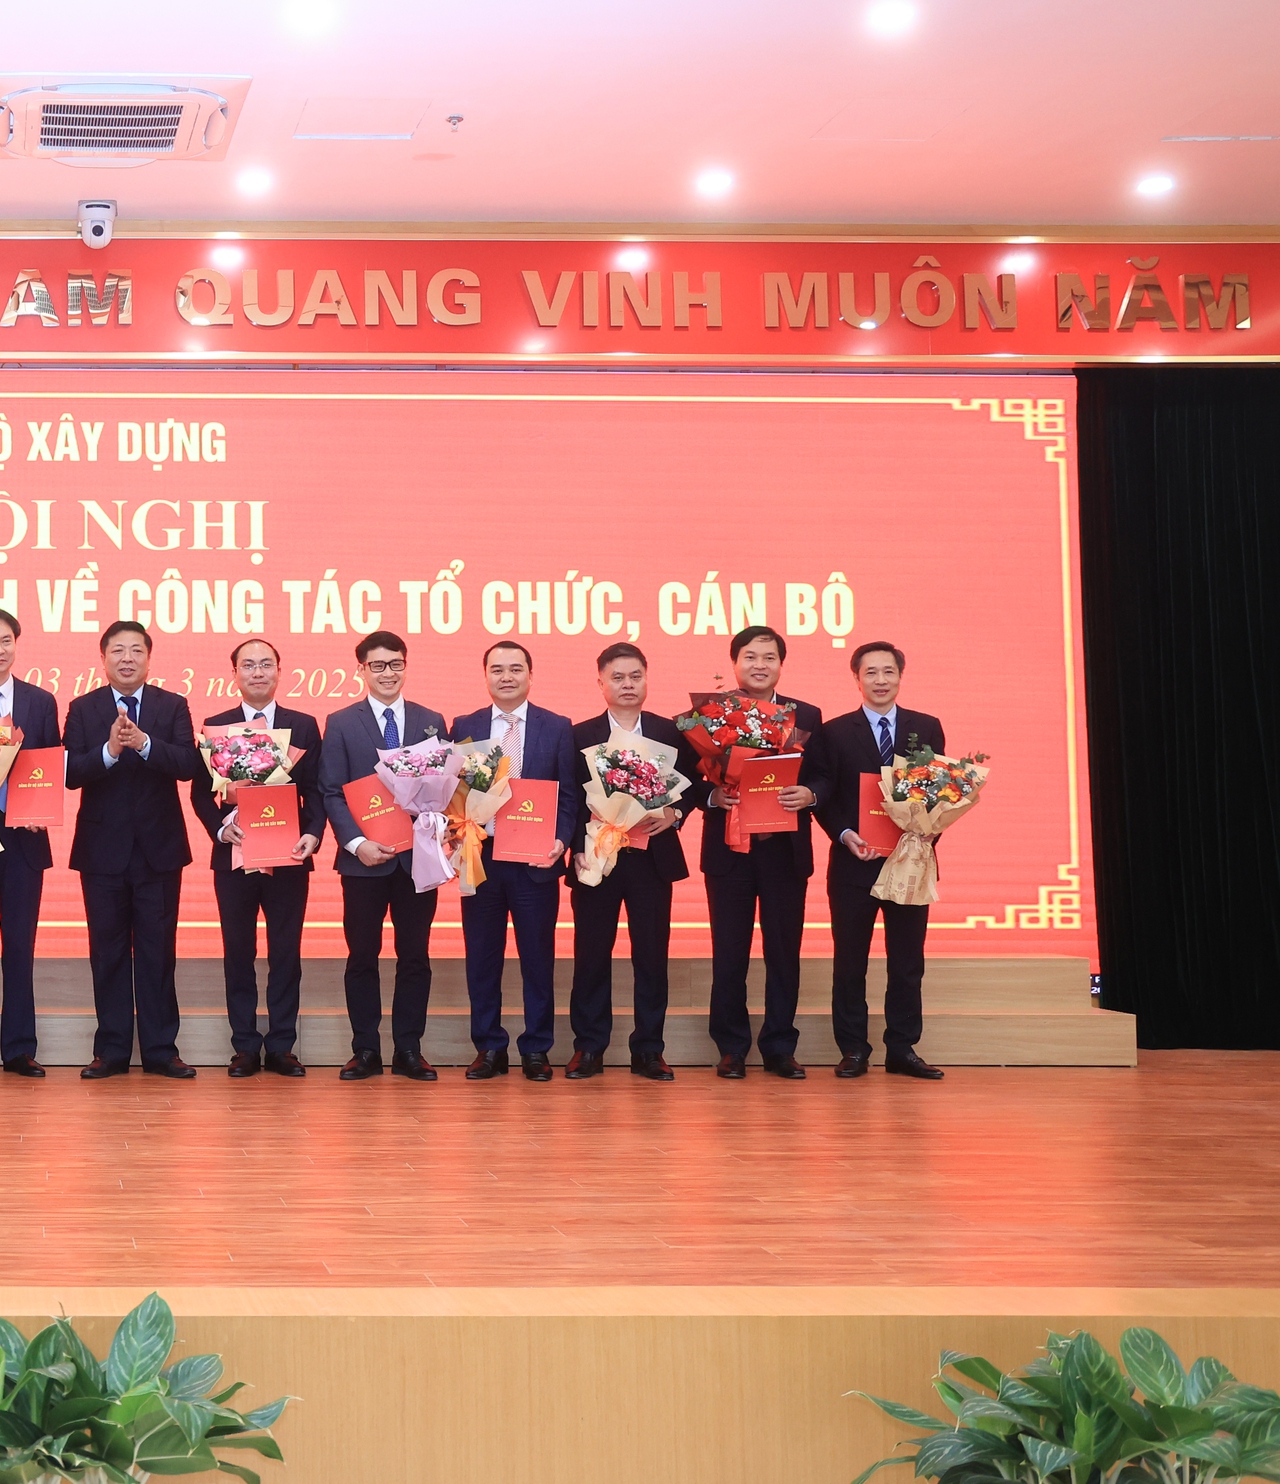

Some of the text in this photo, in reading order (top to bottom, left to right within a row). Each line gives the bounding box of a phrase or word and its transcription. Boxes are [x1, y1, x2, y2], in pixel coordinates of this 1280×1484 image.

[176, 268, 482, 327] QUANG
[521, 270, 722, 328] VINH
[762, 255, 1017, 329] MUÔN
[1055, 256, 1251, 330] NĂM
[26, 413, 105, 462] XÂY
[118, 418, 227, 471] DỰNG
[77, 499, 270, 565] NGHỊ
[35, 561, 100, 633] VỀ
[118, 567, 265, 634] CÔNG
[281, 568, 382, 634] TÁC
[399, 558, 465, 635] TỔ
[481, 569, 640, 642] CHỨC,
[658, 570, 767, 636] CÁN
[785, 571, 855, 649] BỘ
[177, 668, 195, 697] 3
[286, 668, 365, 698] 2025
